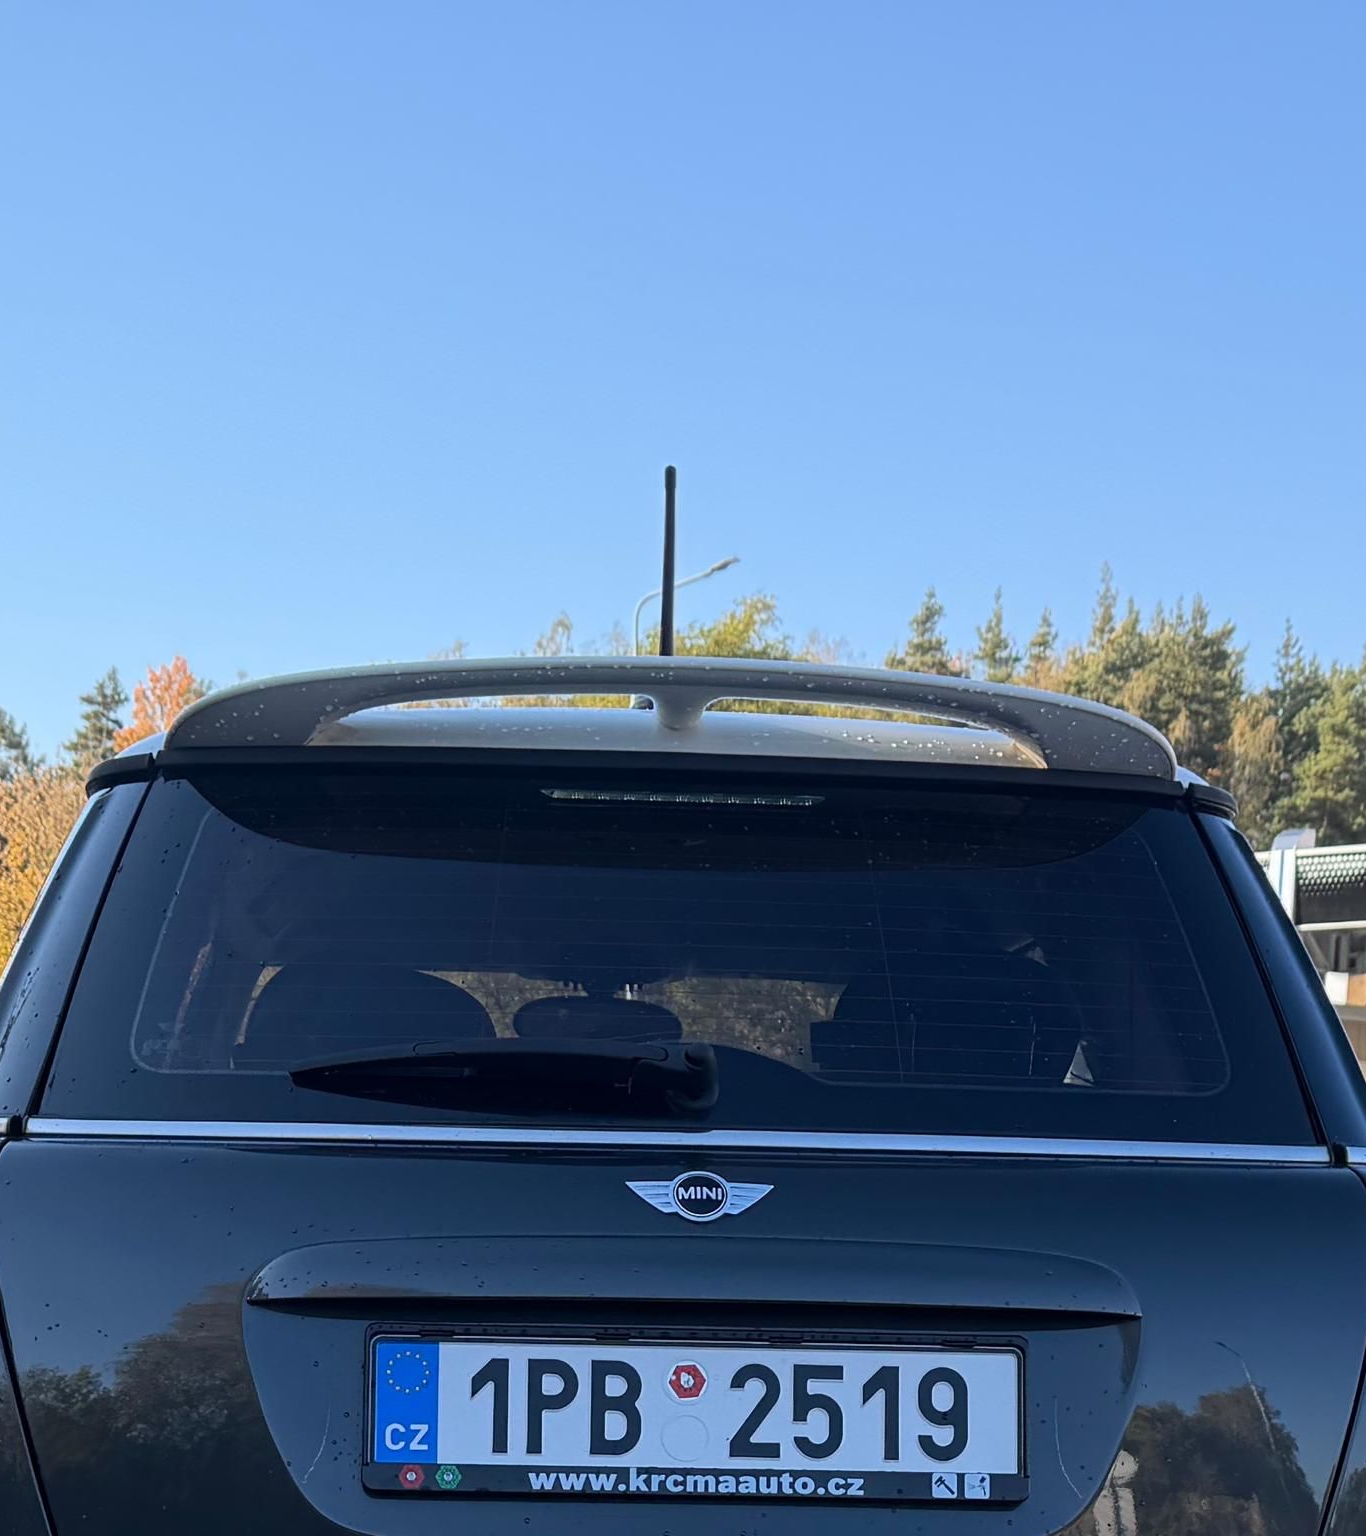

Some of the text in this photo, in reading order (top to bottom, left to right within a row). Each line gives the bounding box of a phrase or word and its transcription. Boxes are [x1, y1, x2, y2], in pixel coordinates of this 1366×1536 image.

[678, 1186, 723, 1200] MINI
[470, 1356, 970, 1463] 1PB 2519
[383, 1422, 429, 1451] CZ
[528, 1469, 866, 1498] www.krcmaauto.cz
